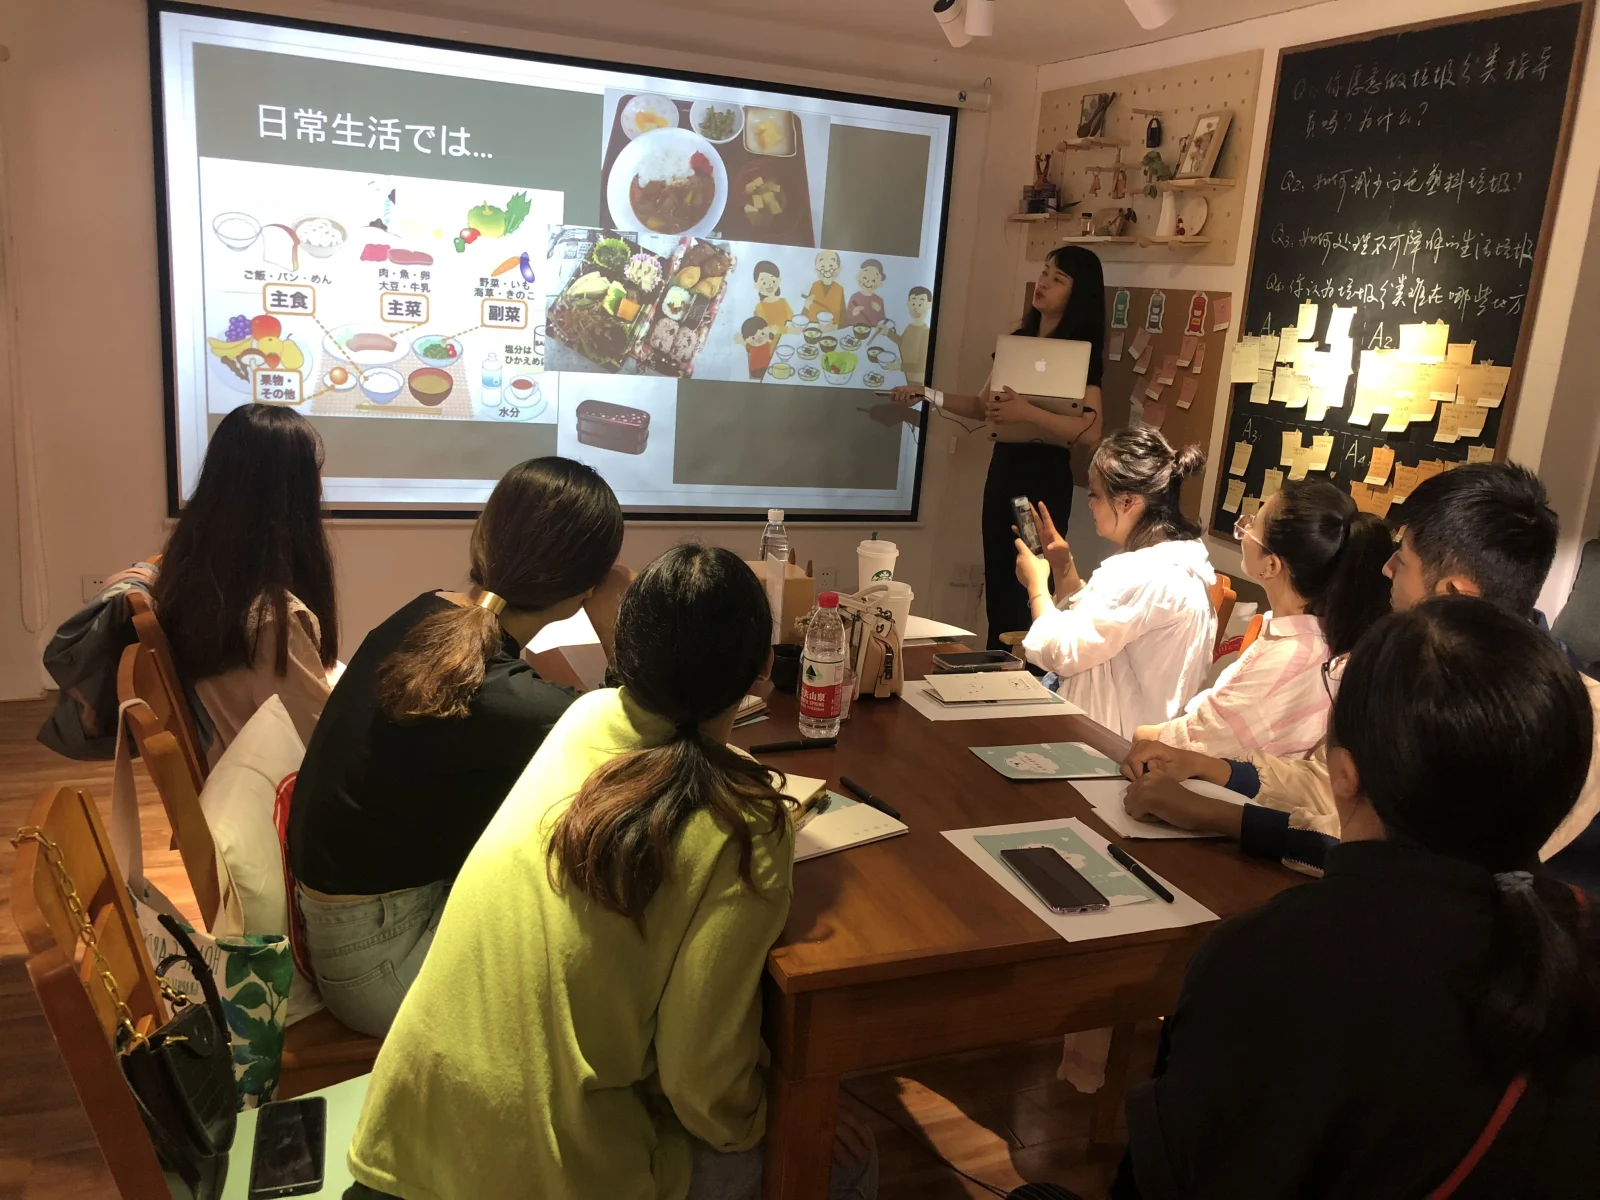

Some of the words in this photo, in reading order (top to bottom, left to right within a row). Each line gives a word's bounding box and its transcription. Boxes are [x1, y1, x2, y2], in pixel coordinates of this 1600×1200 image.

[378, 267, 431, 281] 肉・魚・卵
[378, 280, 431, 293] 大豆・牛乳
[479, 277, 530, 291] 野菜・いも
[270, 290, 308, 310] 主食
[387, 299, 422, 318] 主菜
[488, 305, 521, 323] 副菜
[504, 344, 532, 355] 塩分は
[260, 388, 296, 400] その他
[498, 406, 521, 418] 水分
[801, 689, 826, 702] 夫山泉
